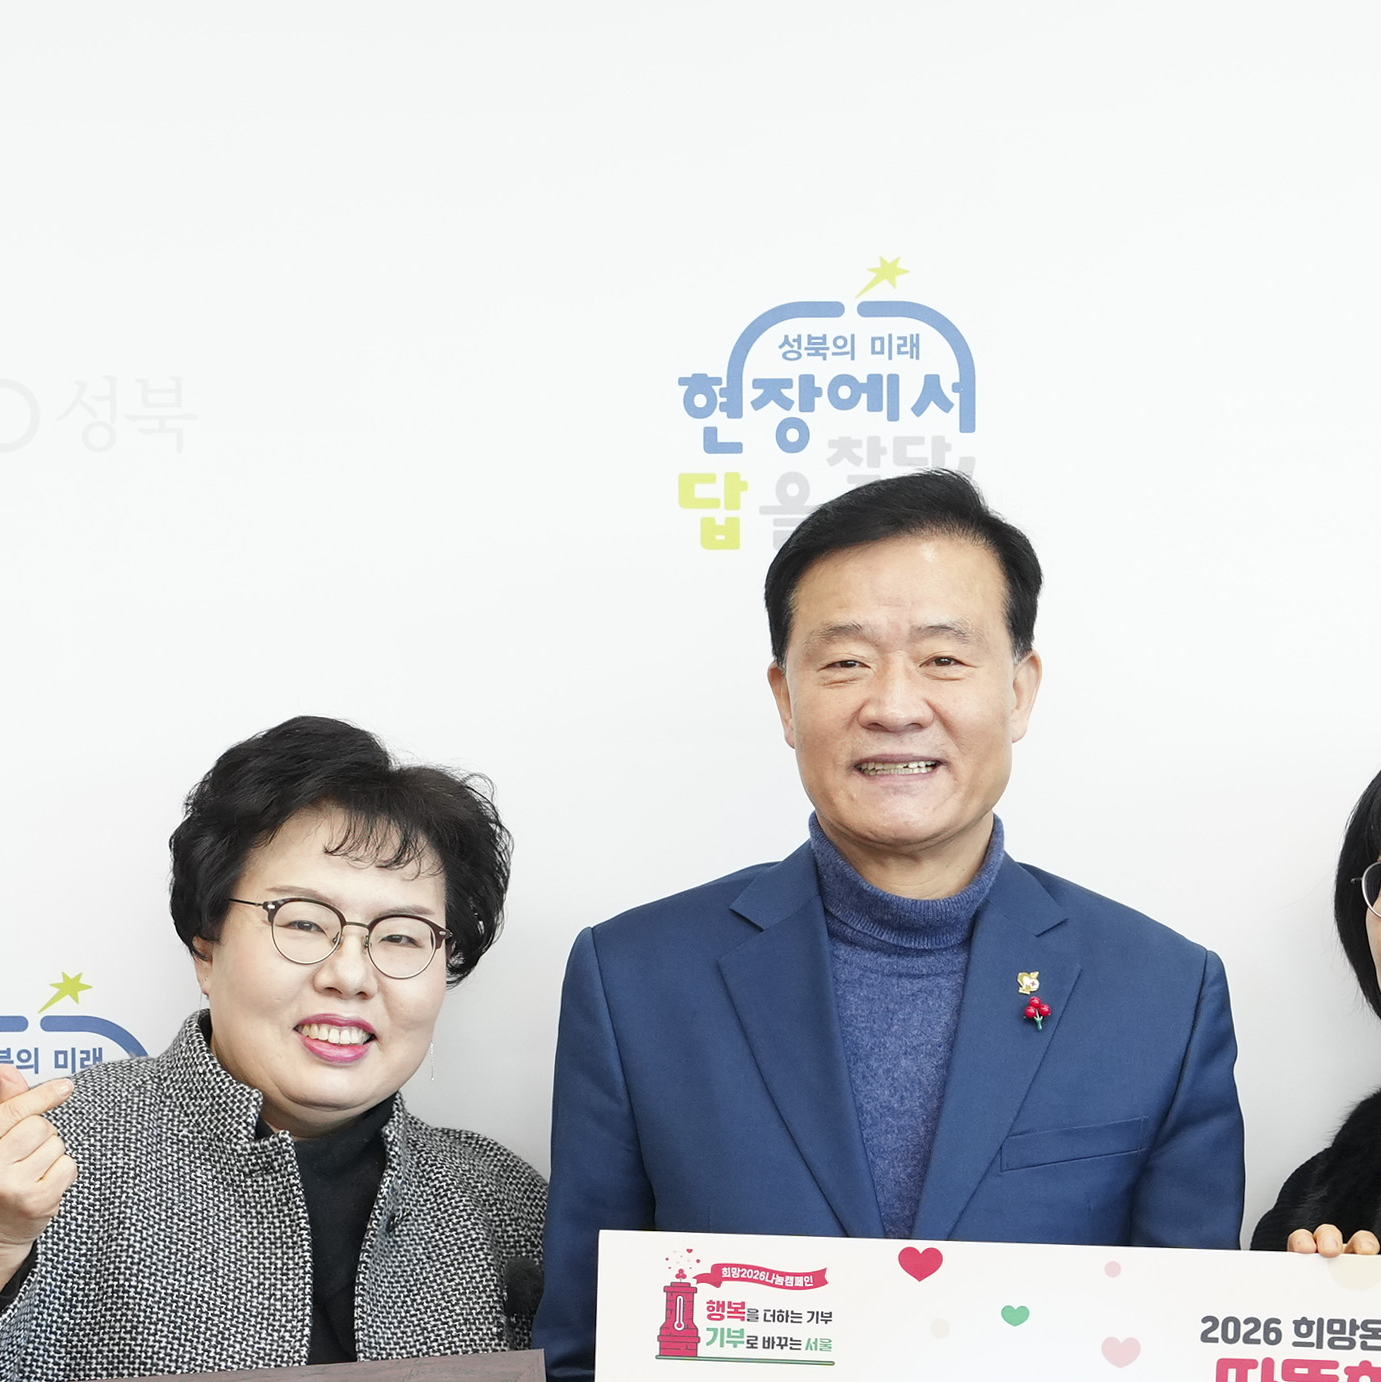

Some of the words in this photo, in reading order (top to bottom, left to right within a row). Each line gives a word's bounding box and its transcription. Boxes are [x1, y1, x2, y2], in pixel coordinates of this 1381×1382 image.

[778, 333, 855, 361] 성북의
[870, 333, 920, 361] 미래
[55, 374, 198, 455] 성북
[678, 373, 976, 454] 현장에서
[721, 1267, 814, 1287] 희망2026나눔캠페인
[706, 1300, 759, 1323] 행복을
[763, 1308, 803, 1324] 더하는
[806, 1310, 833, 1325] 기부
[706, 1327, 758, 1350] 기부로
[762, 1335, 802, 1351] 바꾸는
[804, 1337, 833, 1352] 서울
[1200, 1315, 1283, 1346] 2026
